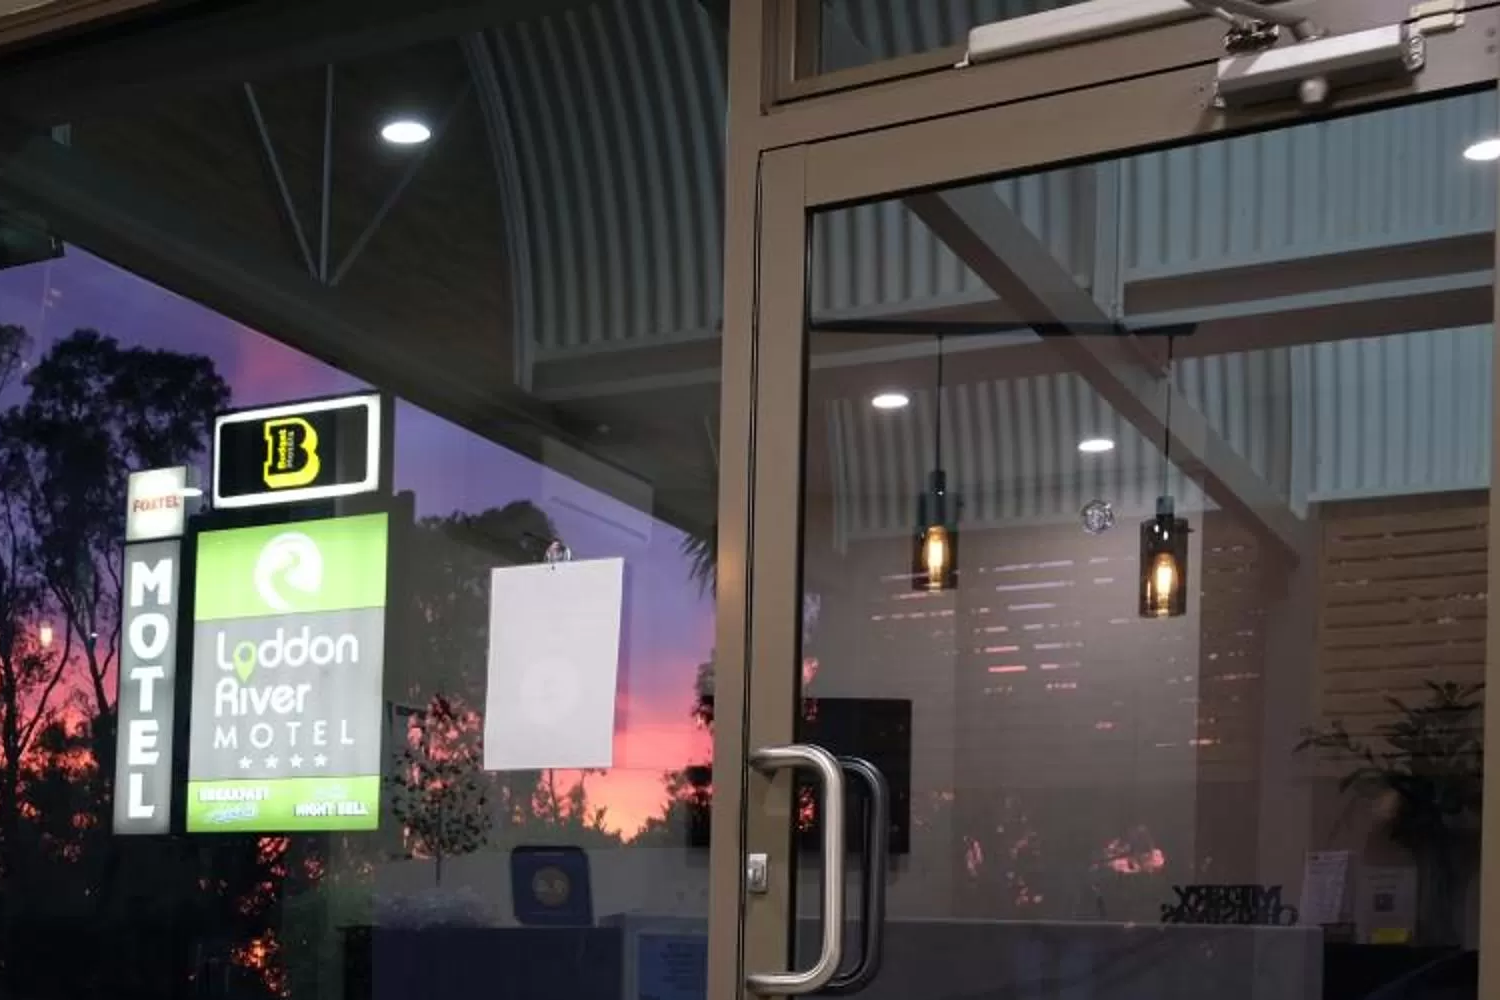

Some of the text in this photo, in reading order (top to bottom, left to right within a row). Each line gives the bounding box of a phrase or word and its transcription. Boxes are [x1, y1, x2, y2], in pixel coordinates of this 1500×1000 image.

[216, 625, 359, 673] Loddon
[128, 558, 173, 819] MOTEL
[214, 676, 312, 717] River
[213, 719, 356, 749] MOTEL
